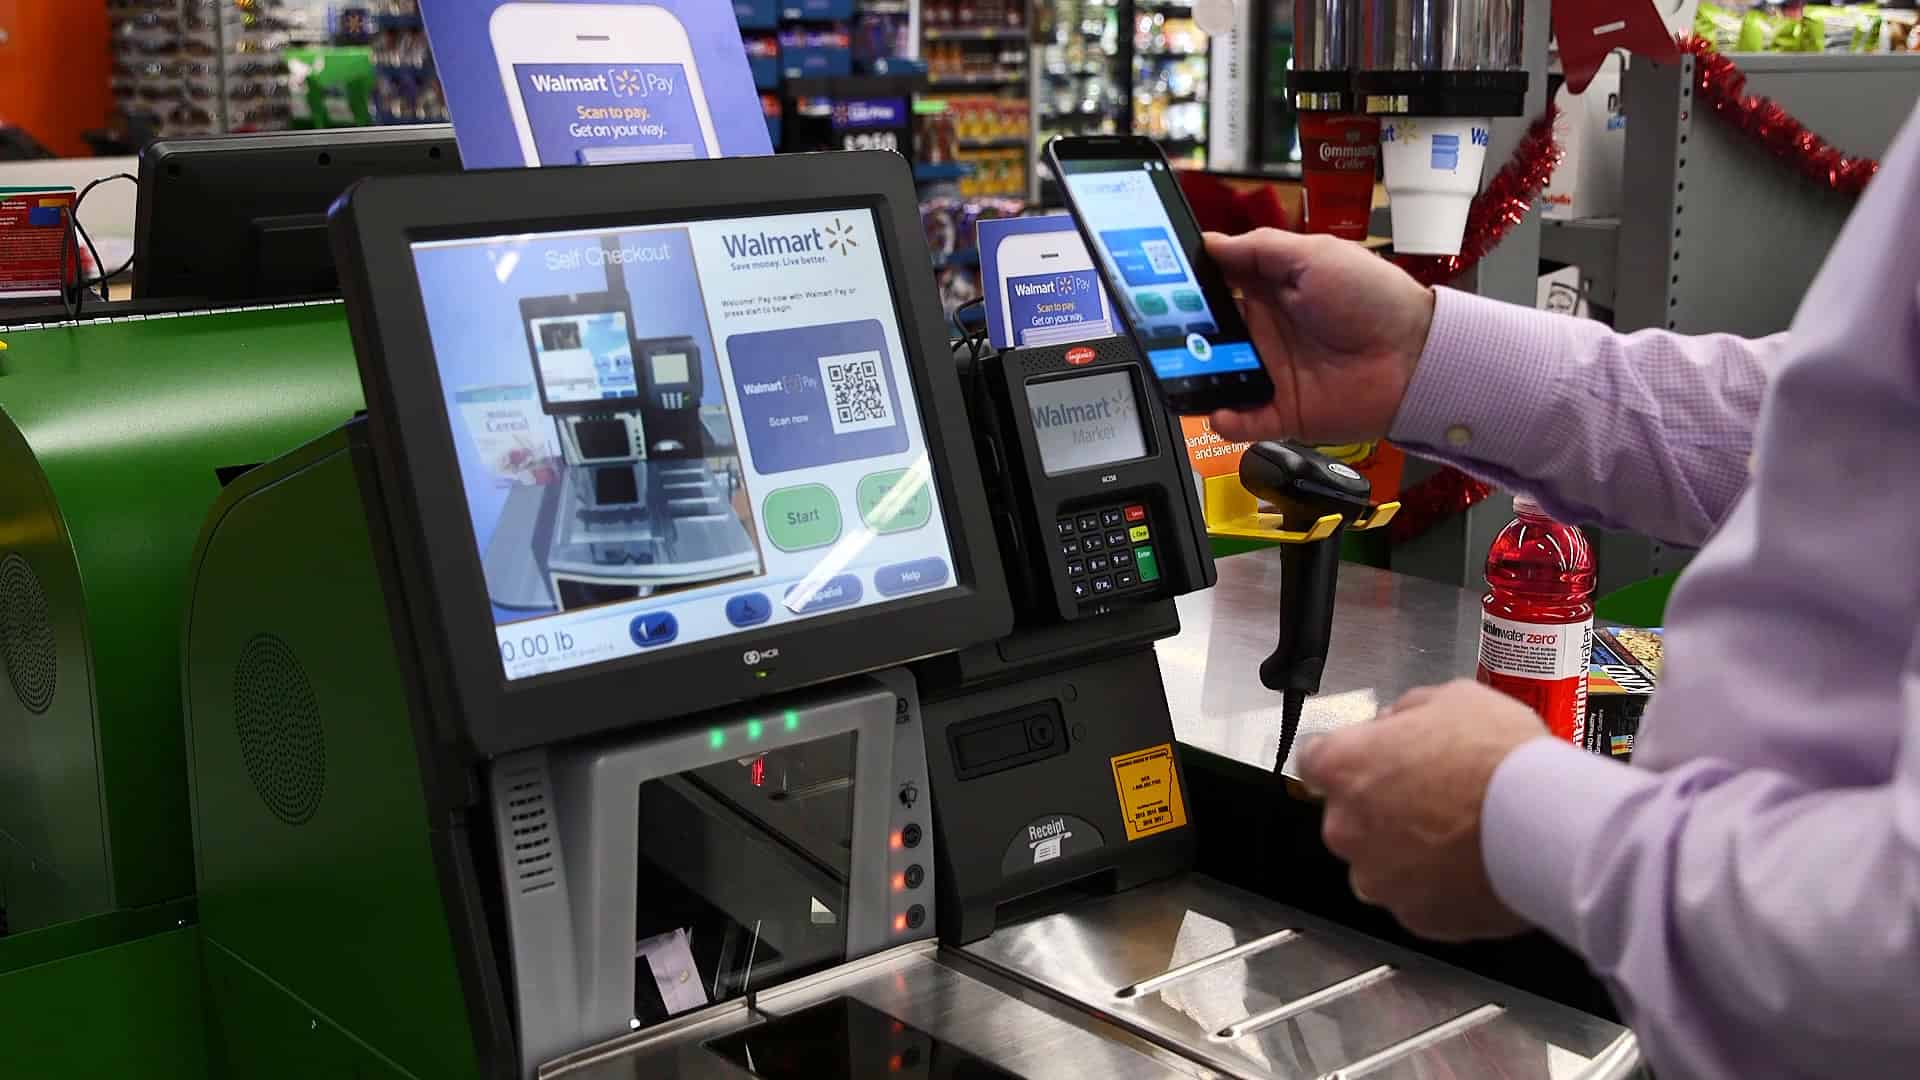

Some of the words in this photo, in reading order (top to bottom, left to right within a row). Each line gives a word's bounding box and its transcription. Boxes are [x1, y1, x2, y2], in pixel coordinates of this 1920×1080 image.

[531, 74, 608, 92] Walmart
[647, 73, 673, 95] Pay
[576, 105, 609, 119] Scan
[609, 106, 623, 119] to
[624, 107, 650, 122] pay.
[569, 123, 593, 138] Get
[593, 125, 611, 137] on
[611, 125, 639, 140] your
[639, 123, 668, 139] way.
[722, 227, 824, 259] Walmart
[544, 248, 581, 271] Self
[585, 243, 673, 267] Checkout
[730, 262, 751, 271] Save
[782, 257, 799, 266] Live
[1015, 281, 1056, 297] Walmart
[1076, 277, 1091, 293] Pay
[1036, 303, 1054, 313] Scan
[1031, 315, 1043, 326] Get
[743, 380, 783, 395] Walmart
[768, 415, 791, 427] Scan
[791, 413, 809, 424] now
[1032, 397, 1112, 429] Walmart
[1071, 423, 1115, 446] Market
[1195, 445, 1213, 460] and
[1213, 443, 1232, 457] save
[786, 508, 820, 526] Start
[900, 571, 921, 583] Help
[502, 633, 550, 663] 0.00
[554, 628, 574, 652] lb
[1600, 664, 1656, 696] KIND
[1028, 817, 1065, 841] Receipt
